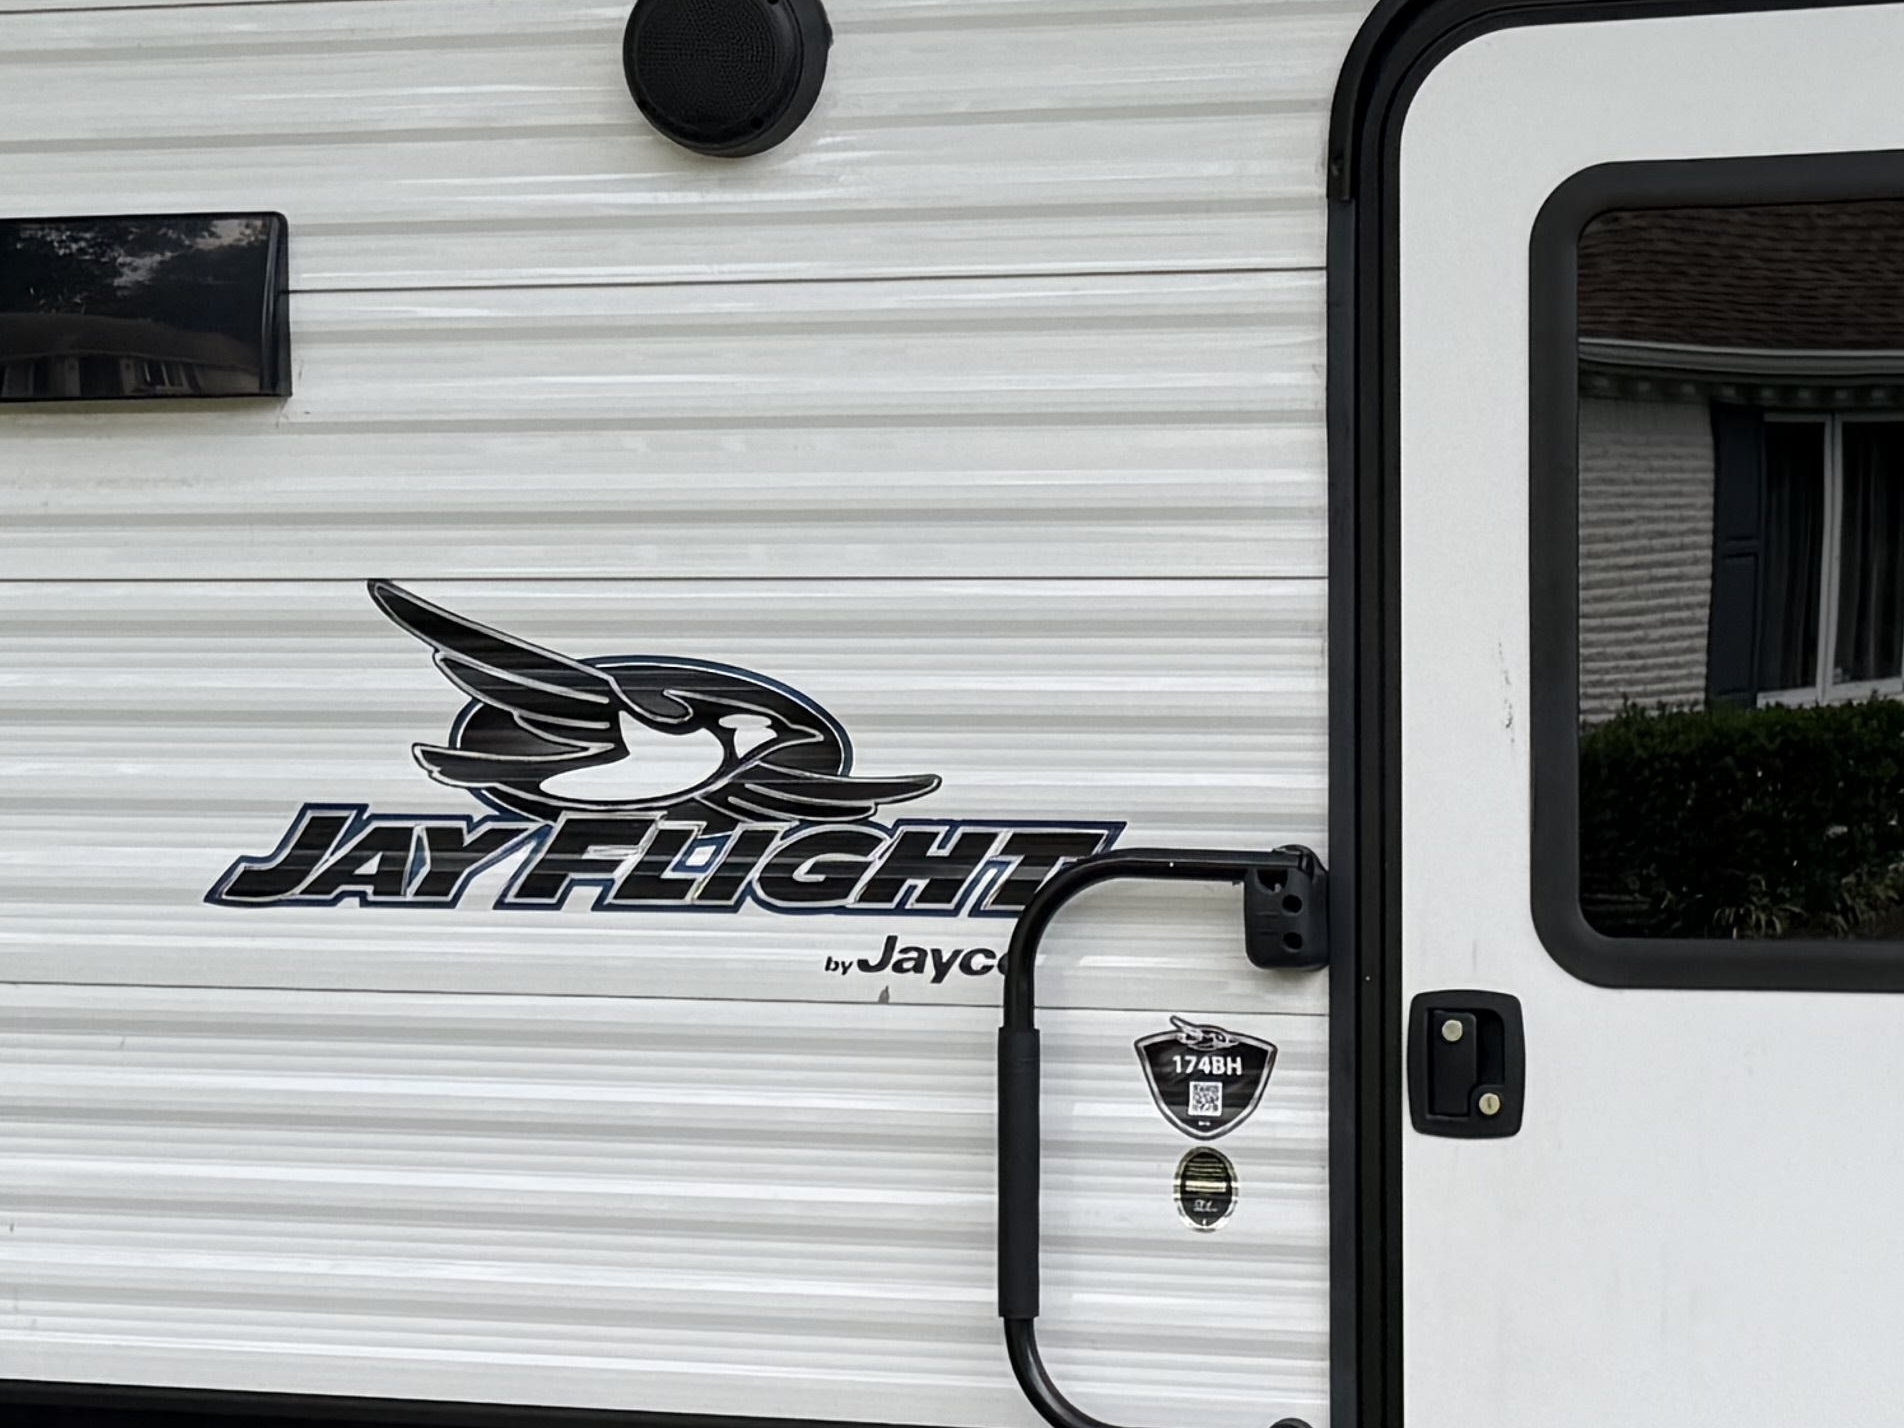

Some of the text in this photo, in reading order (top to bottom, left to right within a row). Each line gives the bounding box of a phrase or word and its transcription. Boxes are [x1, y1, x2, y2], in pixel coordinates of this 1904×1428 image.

[205, 803, 1126, 917] JAY FLIGHT
[825, 956, 854, 976] by
[1172, 1055, 1242, 1076] 174BH
